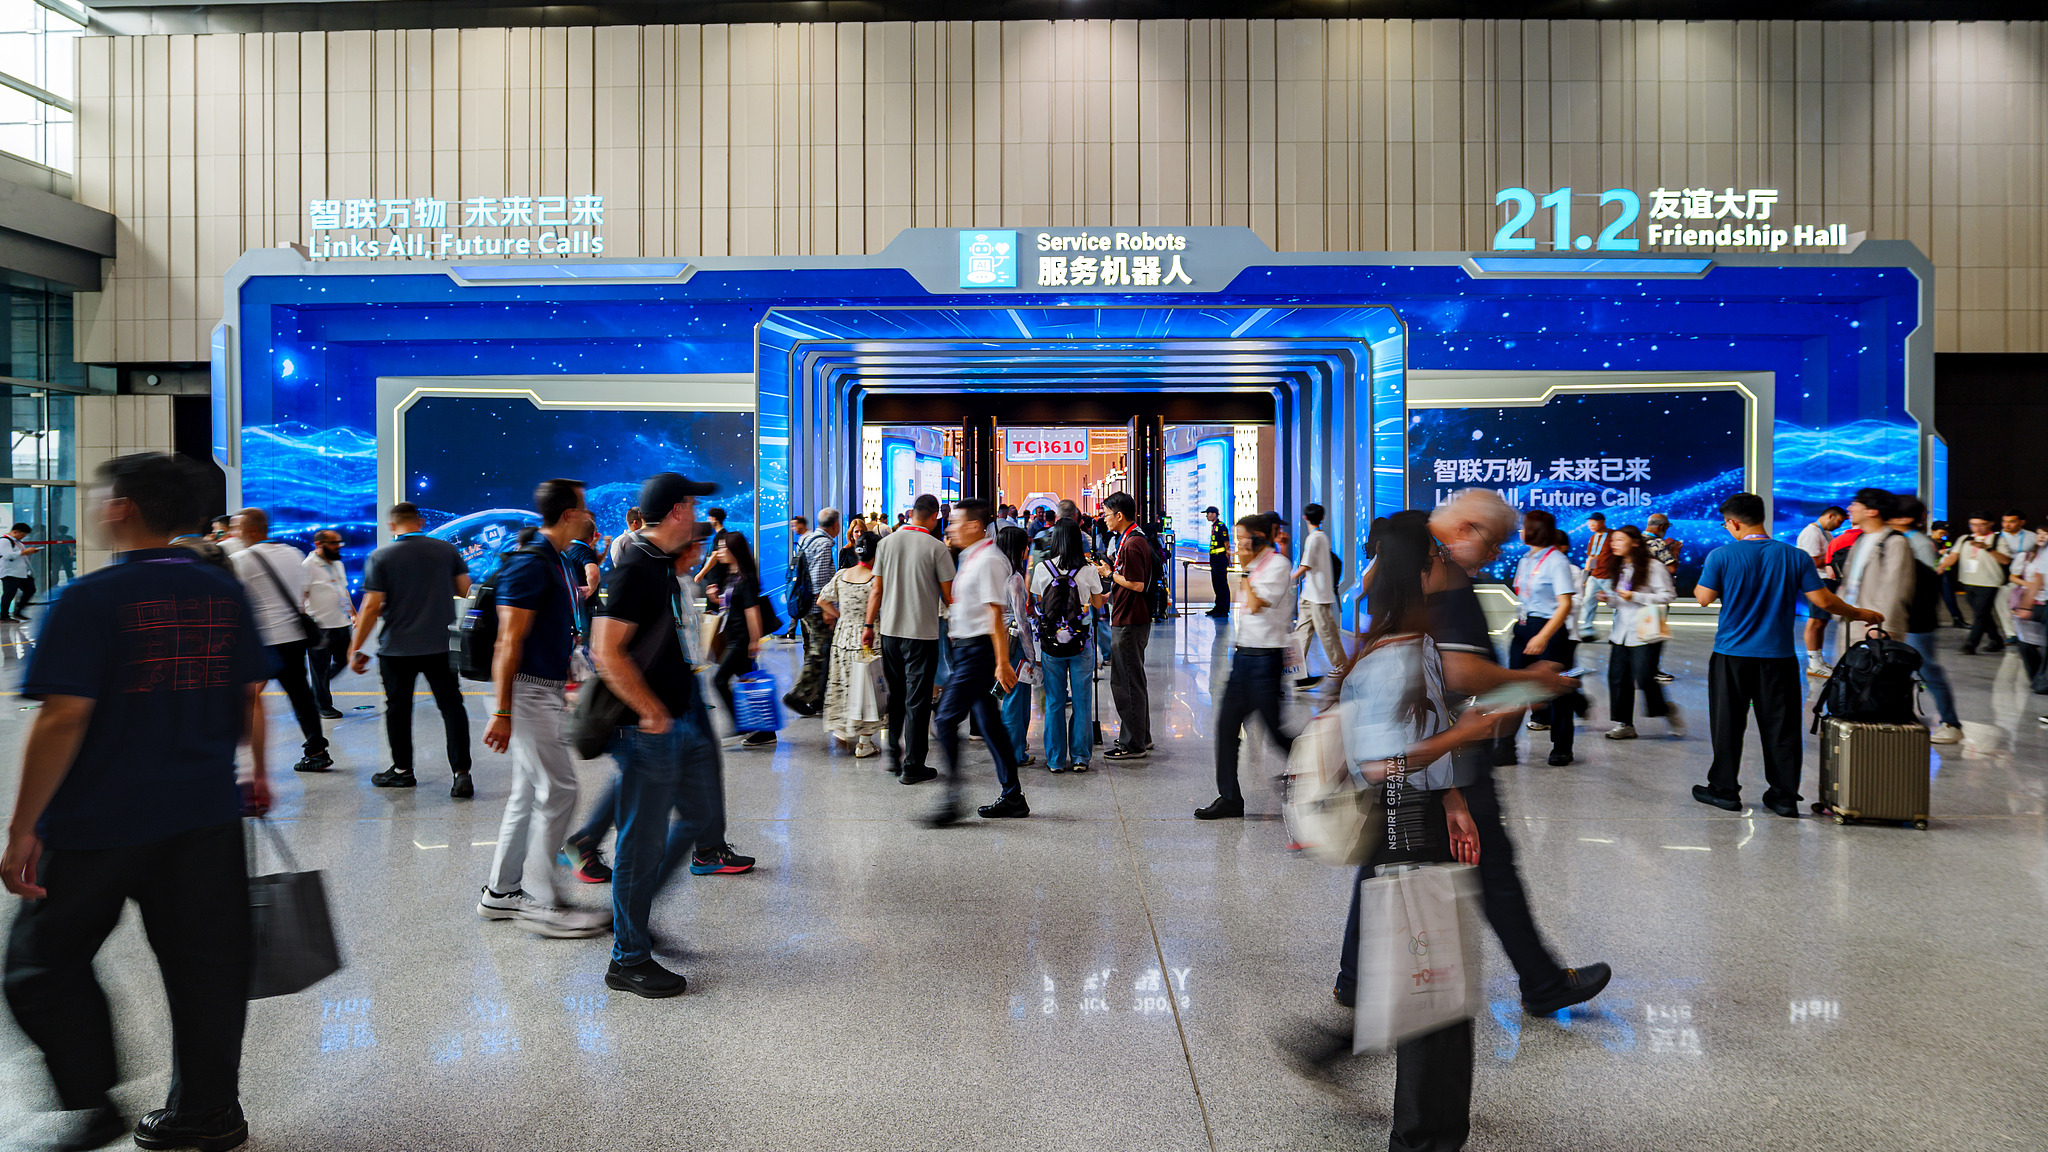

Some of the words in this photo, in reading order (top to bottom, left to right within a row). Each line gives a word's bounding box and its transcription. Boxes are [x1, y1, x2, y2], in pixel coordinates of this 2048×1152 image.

[309, 197, 447, 230] 智联万物
[465, 194, 604, 227] 未来已来
[1648, 188, 1778, 220] 友谊大厅
[1494, 187, 1641, 251] 21.2
[309, 235, 379, 258] Links
[387, 234, 432, 259] All,
[444, 233, 531, 255] Future
[538, 231, 604, 254] Calls
[1037, 232, 1111, 251] Service
[1116, 232, 1186, 251] Robots
[1648, 223, 1788, 251] Friendship
[1794, 224, 1847, 247] Hall
[1037, 255, 1193, 287] 服务机器人
[1012, 440, 1085, 454] TCB610
[1530, 489, 1596, 507] Future
[1601, 488, 1652, 507] Calls
